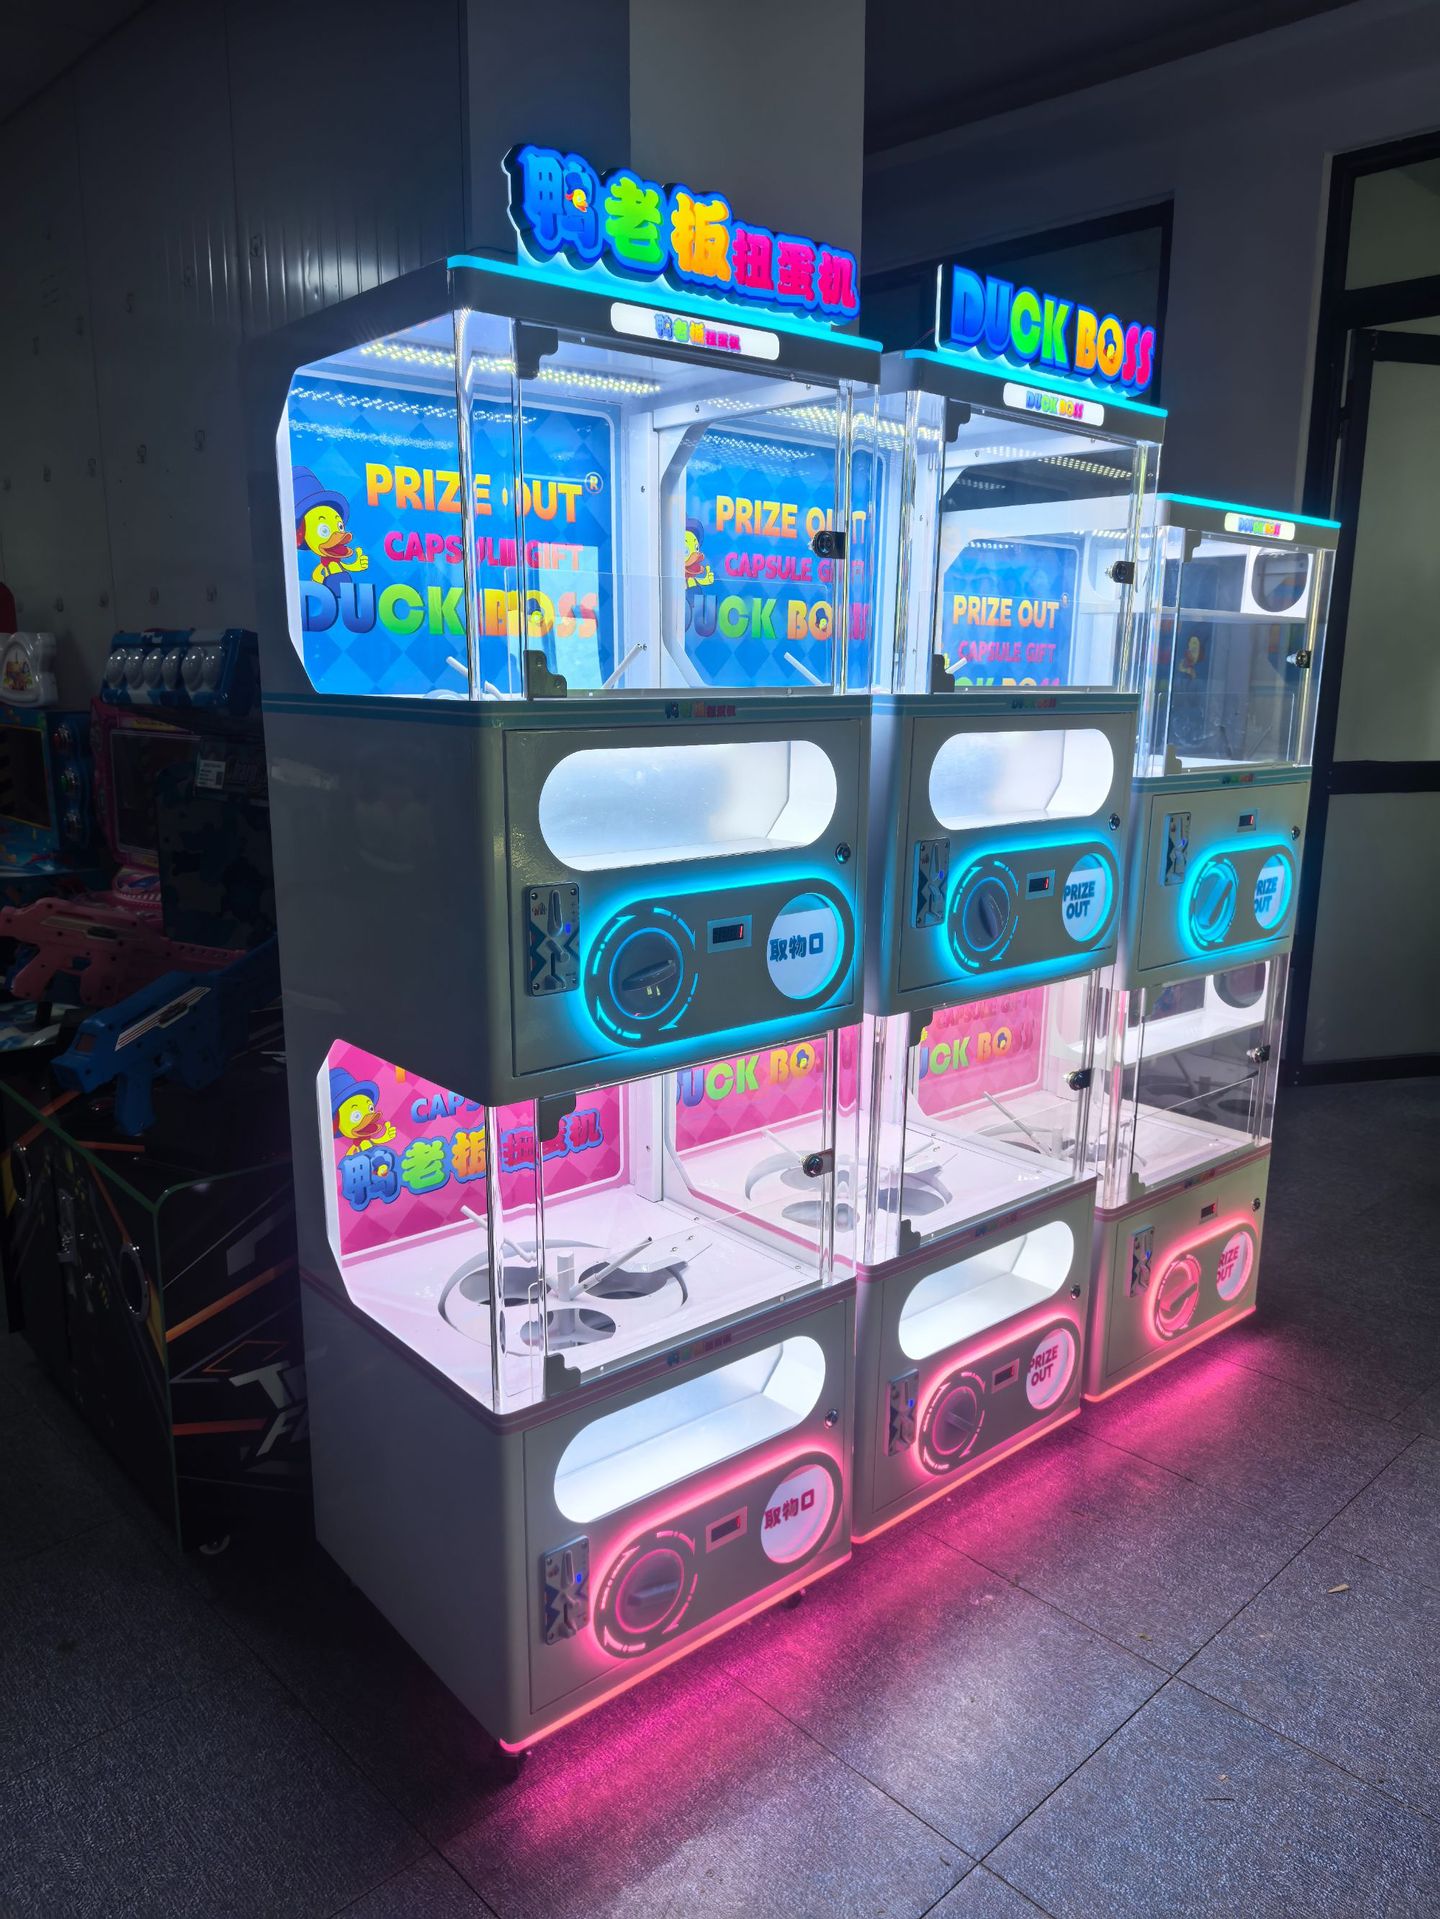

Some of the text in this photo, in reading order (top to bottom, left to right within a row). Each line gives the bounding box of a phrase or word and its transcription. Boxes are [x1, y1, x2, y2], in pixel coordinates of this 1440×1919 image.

[514, 149, 859, 311] 鸭老板扭蛋机
[951, 264, 1157, 390] DUCK BOSS
[1026, 391, 1059, 414] DUCK
[365, 462, 493, 516] PRIZE
[716, 495, 867, 545] PRIZE OT
[725, 552, 812, 582] CAPSULE
[300, 580, 599, 639] DUCK BOSS
[684, 594, 777, 640] UCK
[953, 595, 1060, 629] PRIZE OUT
[958, 641, 1057, 664] CAPSULE GIFT
[1064, 880, 1096, 902] PRIZE
[1256, 876, 1279, 896] RIZE
[1066, 900, 1090, 920] OUT
[769, 932, 824, 962] 取物口
[676, 1054, 760, 1108] UCK
[1218, 1245, 1240, 1269] RIZE
[1029, 1344, 1058, 1374] PRIZE
[1031, 1363, 1054, 1387] OUT
[765, 1488, 815, 1530] 取物口
